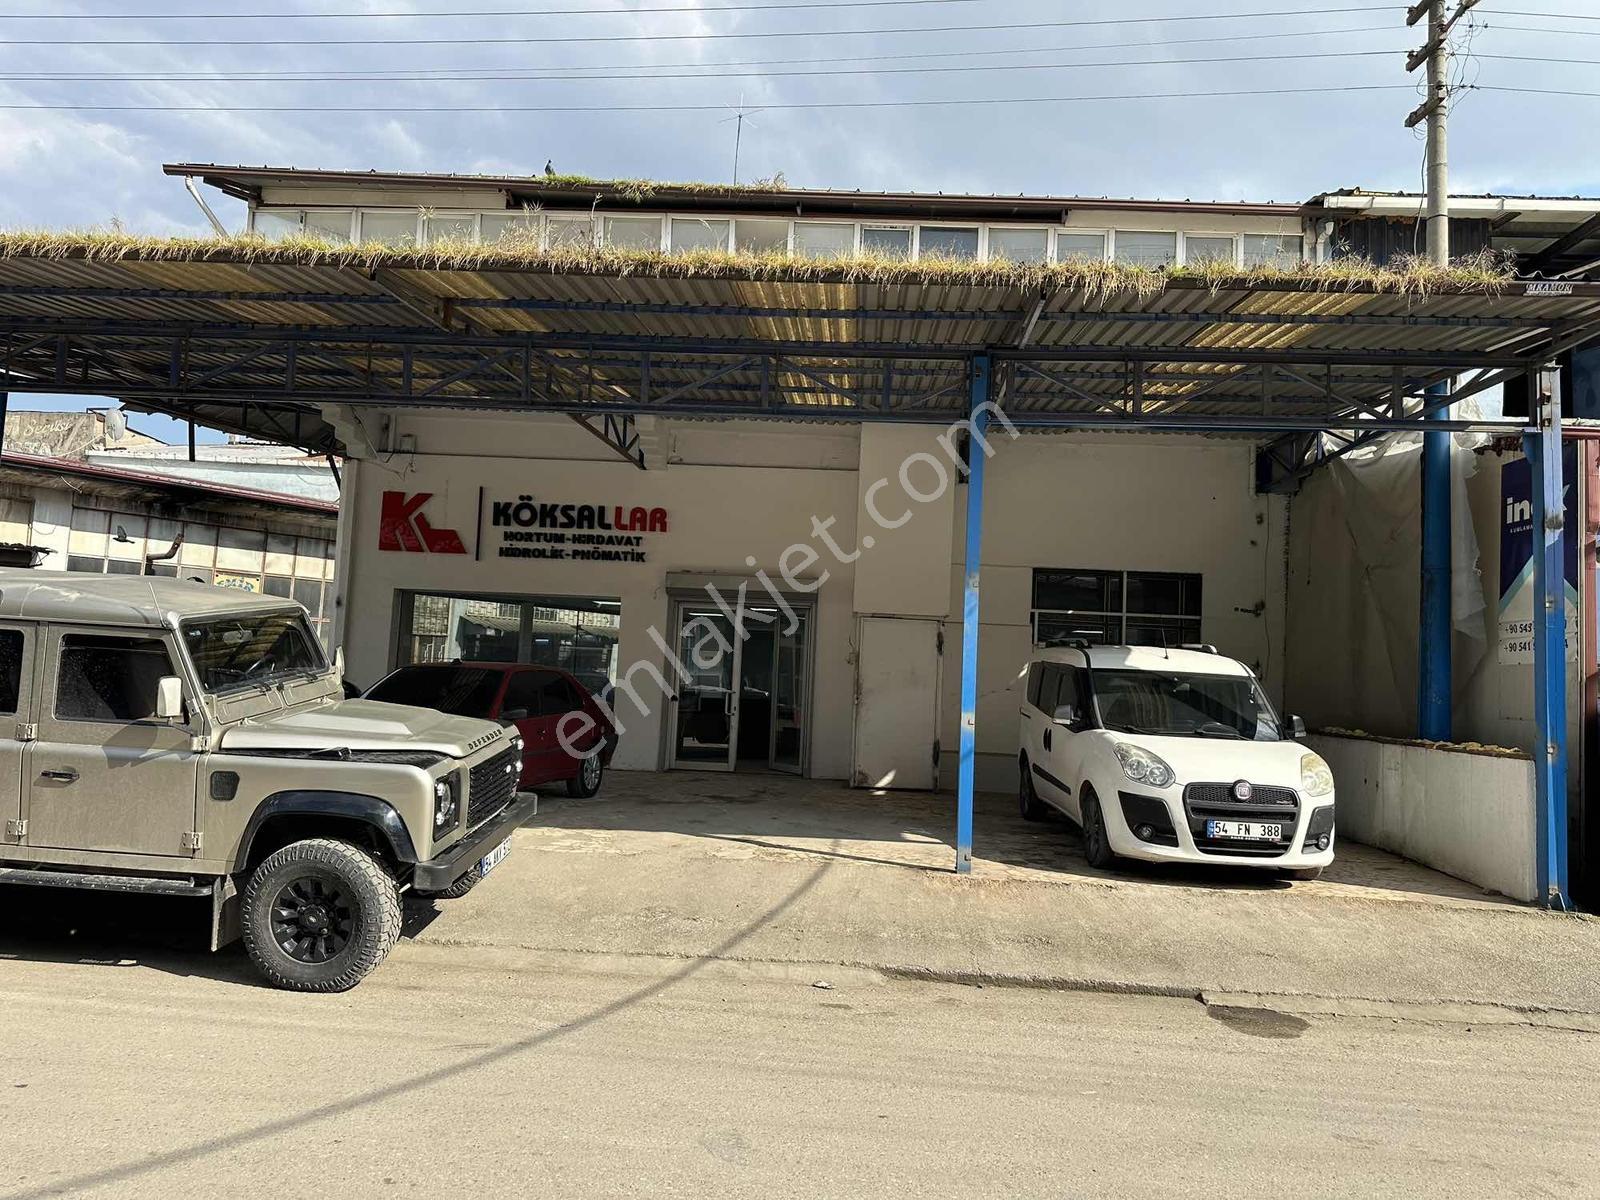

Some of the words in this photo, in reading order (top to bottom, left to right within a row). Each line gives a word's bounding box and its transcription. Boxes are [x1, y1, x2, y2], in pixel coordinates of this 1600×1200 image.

[492, 495, 668, 532] KÖKSALLAR
[468, 729, 503, 750] DEFENDER
[1215, 822, 1228, 834] 54
[1237, 824, 1251, 836] FN
[1260, 825, 1280, 837] 388
